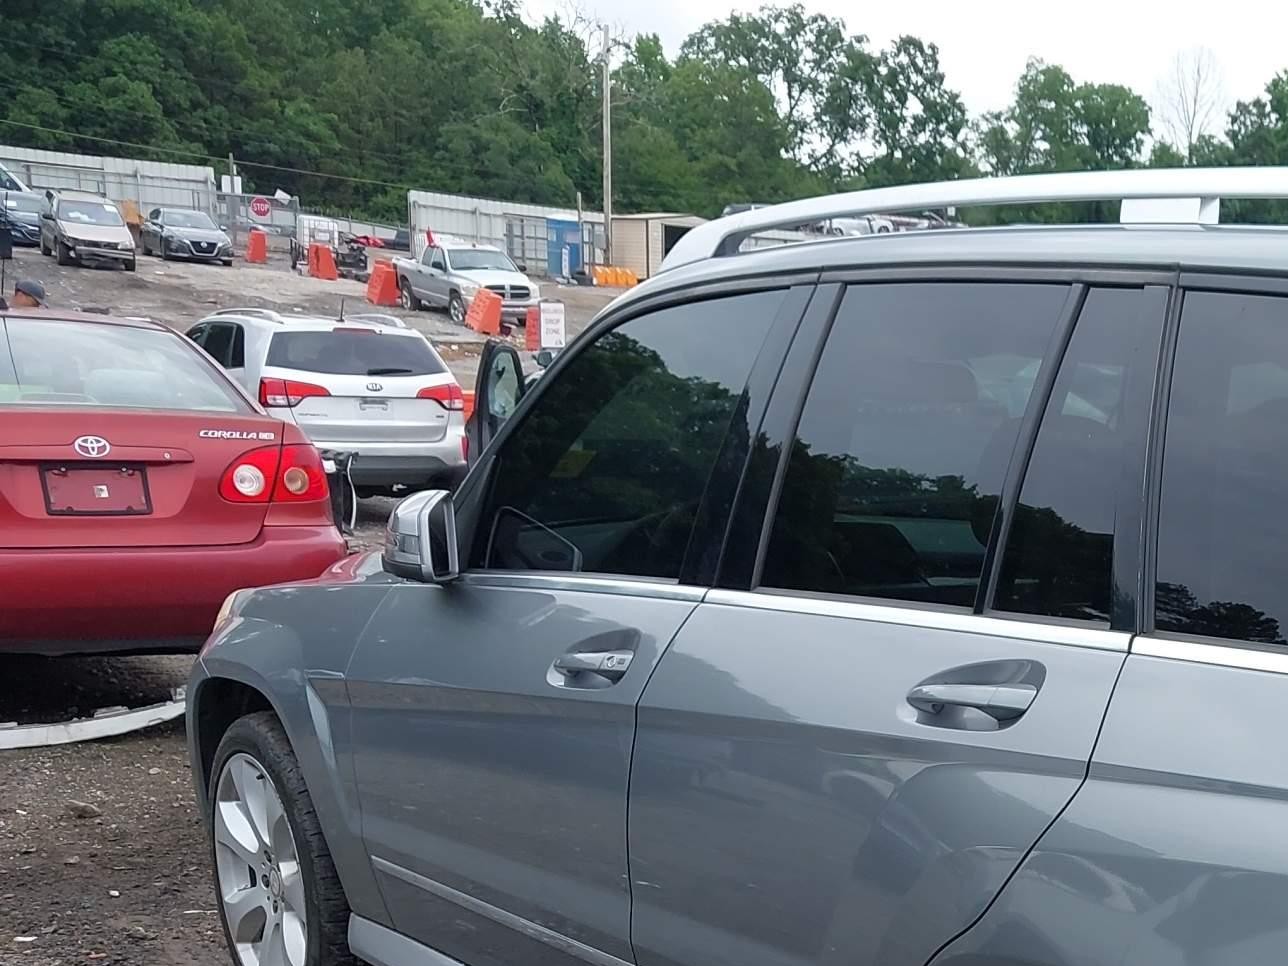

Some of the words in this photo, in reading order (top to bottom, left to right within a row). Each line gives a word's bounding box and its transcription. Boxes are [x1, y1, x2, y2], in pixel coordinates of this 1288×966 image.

[253, 203, 269, 212] STOP
[367, 383, 382, 392] KIA
[199, 429, 258, 440] COROLLA
